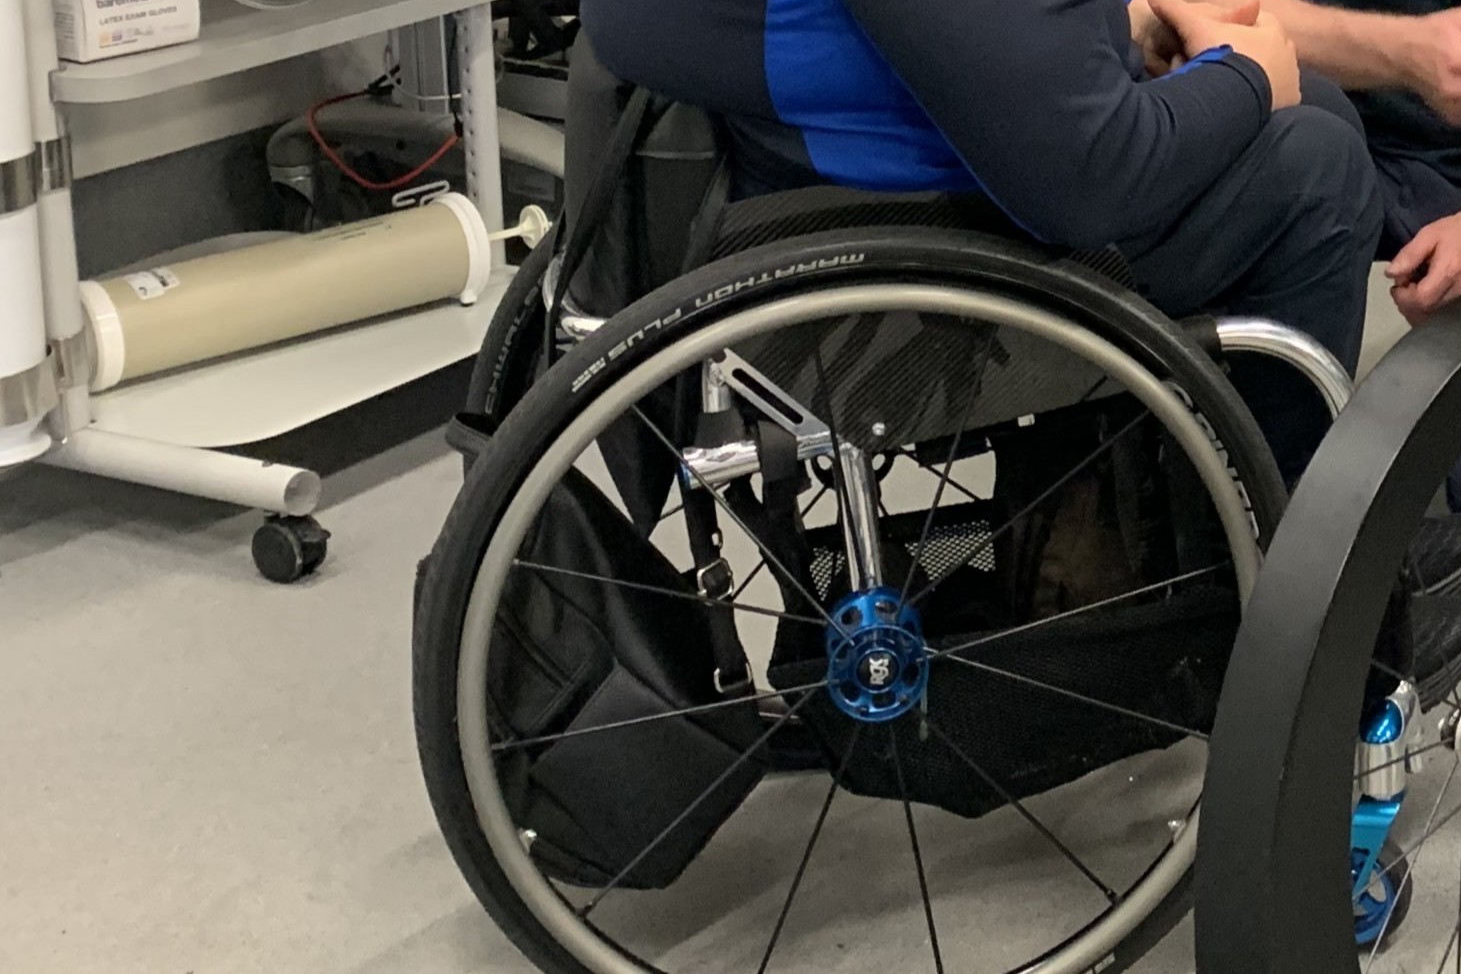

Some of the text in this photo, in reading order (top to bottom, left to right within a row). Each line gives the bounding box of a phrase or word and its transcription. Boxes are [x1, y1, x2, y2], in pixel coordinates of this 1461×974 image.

[99, 14, 123, 26] LATEX
[148, 6, 177, 17] GLOVES
[607, 253, 865, 361] MARATHON PLUS
